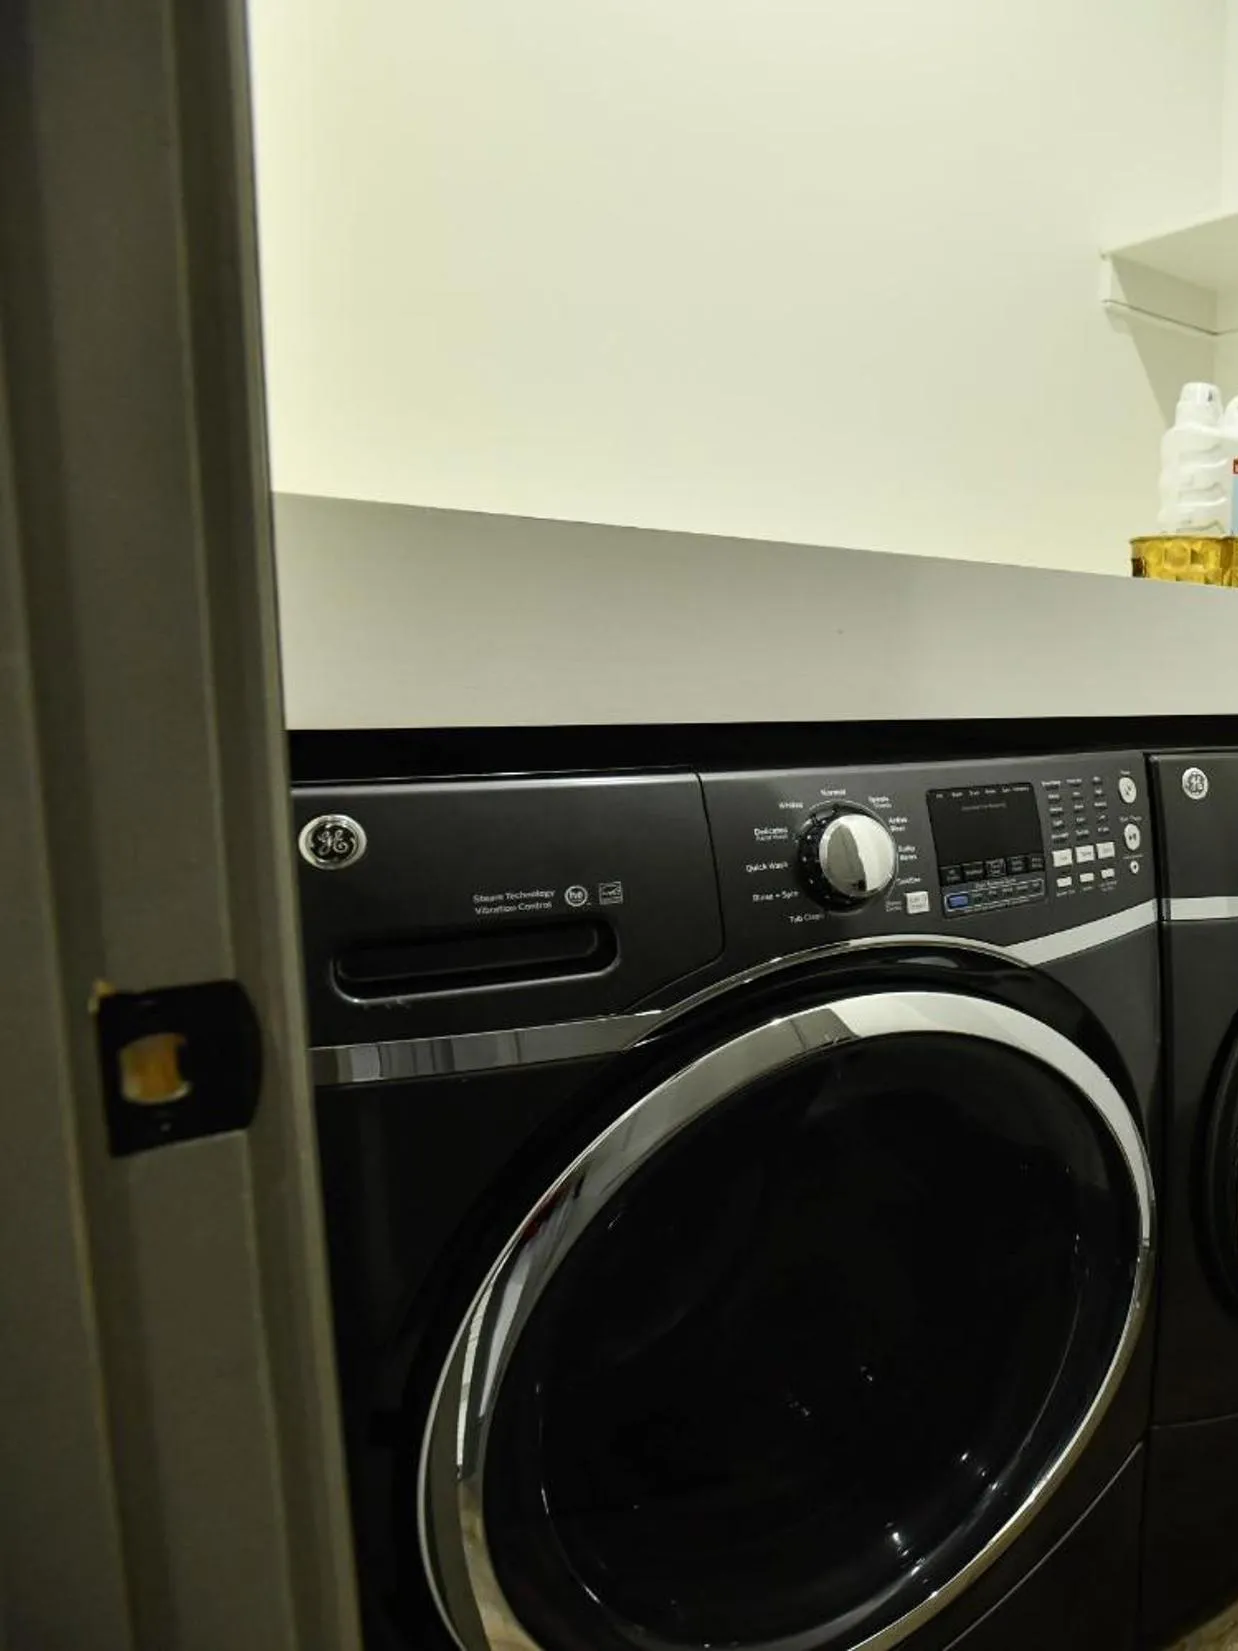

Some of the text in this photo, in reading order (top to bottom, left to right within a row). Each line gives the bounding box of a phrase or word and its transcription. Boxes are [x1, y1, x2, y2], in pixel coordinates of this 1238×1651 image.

[745, 863, 767, 872] Quick
[505, 889, 557, 901] Technology
[518, 901, 553, 911] Control
